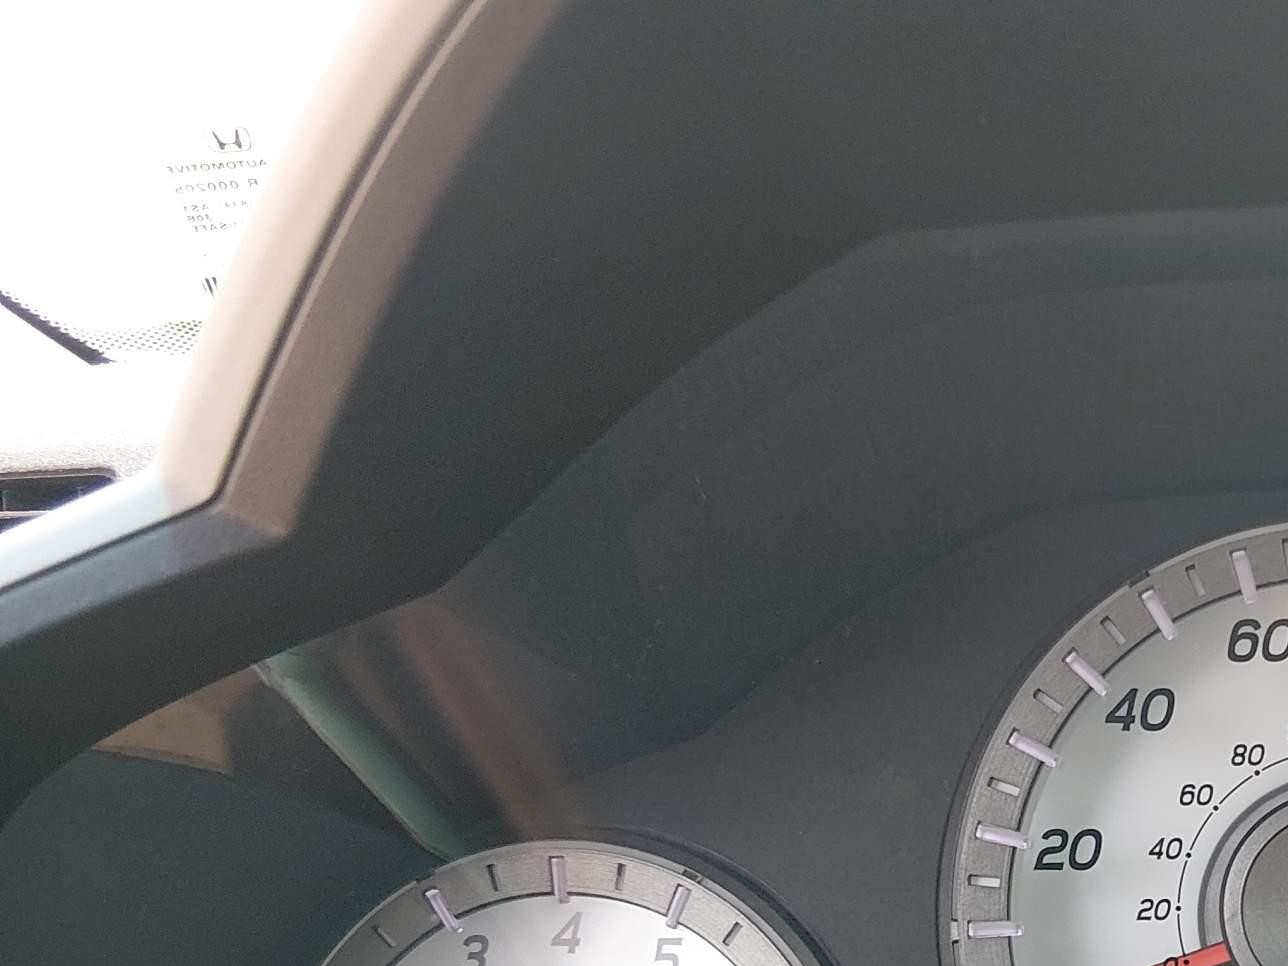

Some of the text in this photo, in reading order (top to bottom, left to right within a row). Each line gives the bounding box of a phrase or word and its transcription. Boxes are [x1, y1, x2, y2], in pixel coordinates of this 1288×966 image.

[1105, 688, 1176, 732] 40
[1231, 744, 1265, 766] 80
[1179, 784, 1214, 806] 60
[1033, 828, 1103, 871] 20
[1148, 837, 1183, 860] 40
[1136, 898, 1172, 920] 20
[551, 911, 582, 954] 4
